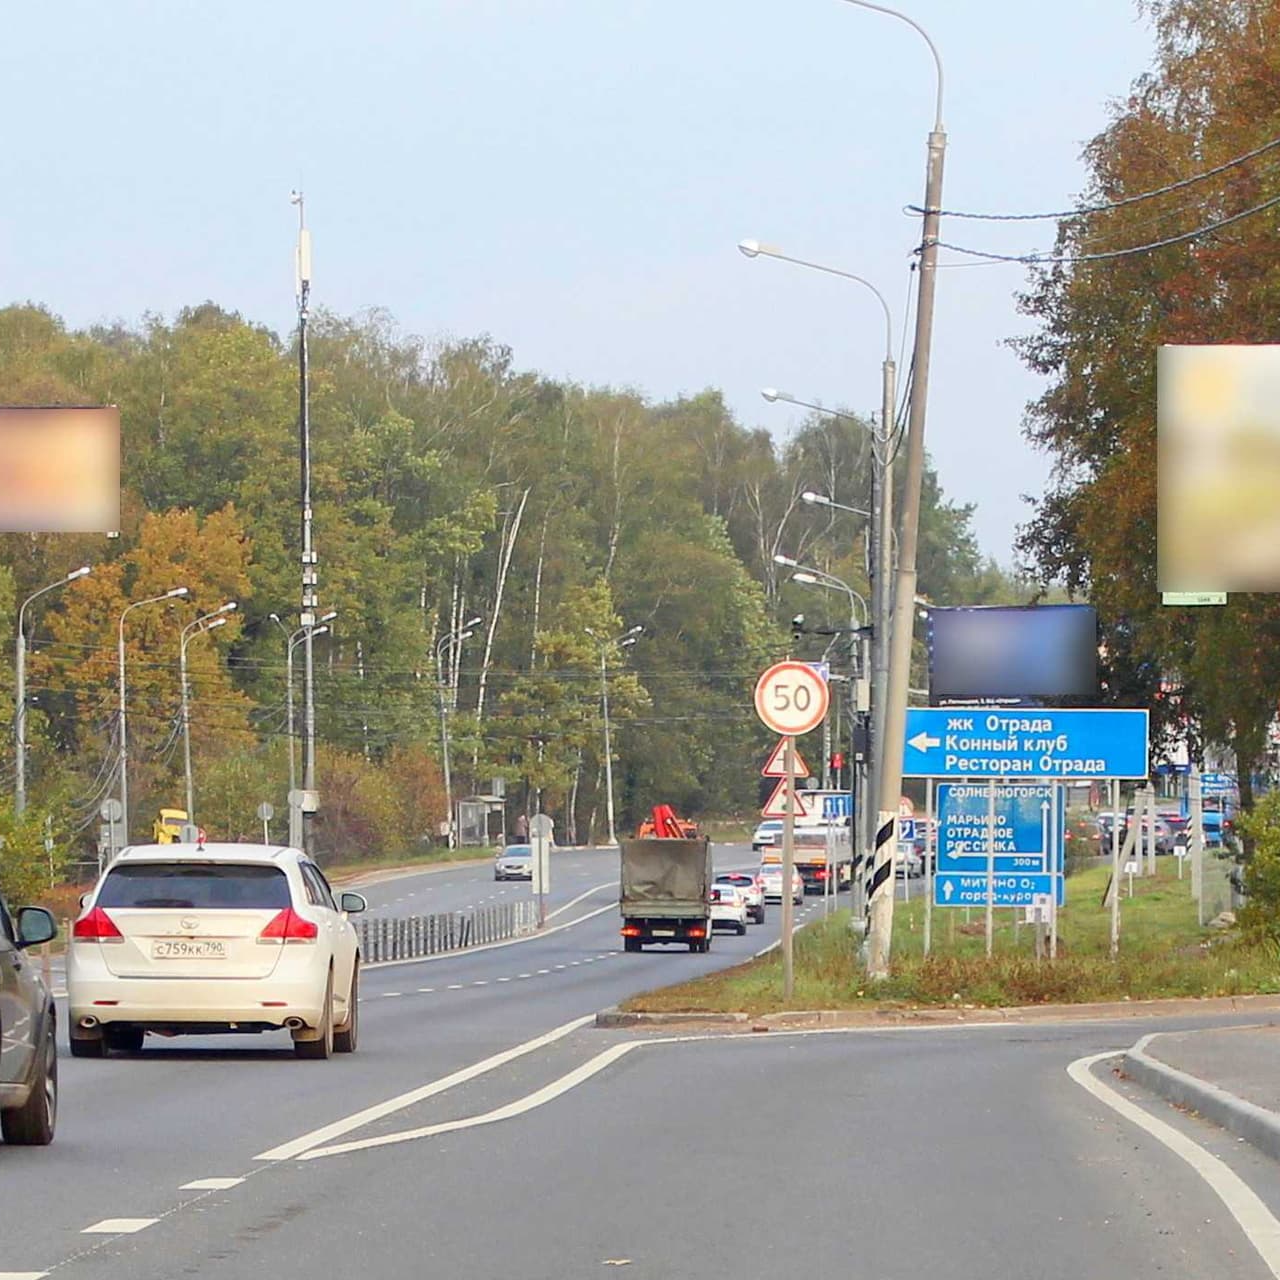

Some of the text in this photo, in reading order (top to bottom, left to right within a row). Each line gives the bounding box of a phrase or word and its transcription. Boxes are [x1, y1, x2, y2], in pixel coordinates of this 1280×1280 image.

[774, 684, 811, 711] 50
[986, 715, 1053, 734] Отрада
[945, 735, 1068, 755] Конный клуб
[945, 755, 1106, 774] Ресторан Отрада
